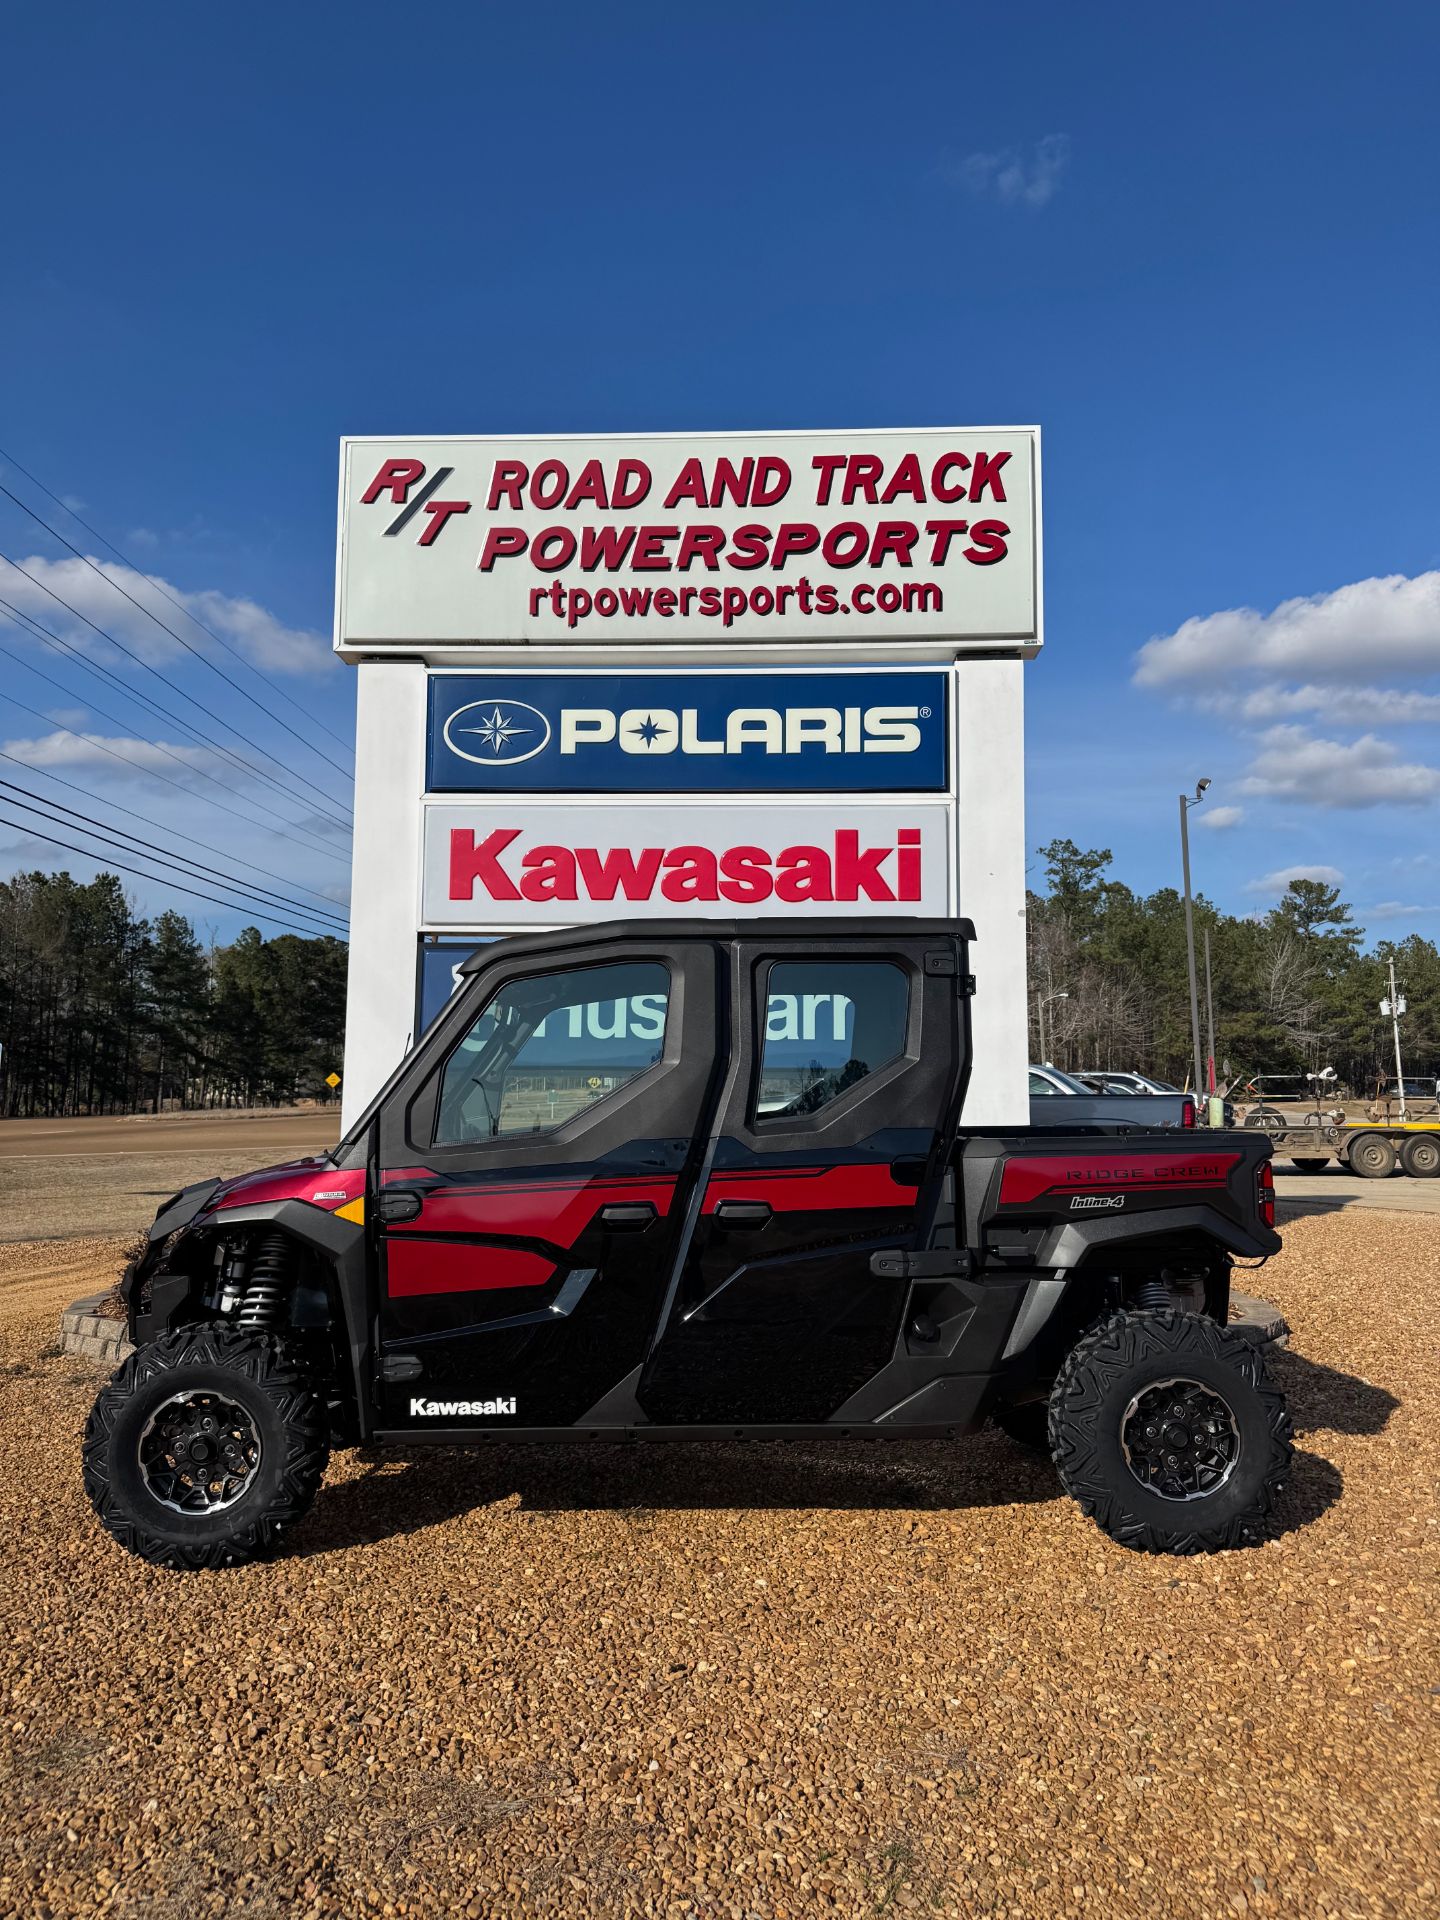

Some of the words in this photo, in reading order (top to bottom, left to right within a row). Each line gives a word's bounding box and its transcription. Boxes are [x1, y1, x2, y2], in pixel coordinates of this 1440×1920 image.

[484, 458, 652, 510] ROAD
[662, 456, 792, 508] AND
[811, 451, 1012, 505] TRACK
[476, 518, 1011, 573] POWERSPORTS
[528, 576, 943, 628] rtpowersports.com
[449, 828, 921, 902] Kawasaki
[1066, 1168, 1145, 1180] RIDGE
[1153, 1166, 1219, 1178] CREW
[1070, 1195, 1124, 1209] Inline-4
[410, 1397, 517, 1416] Kawasaki
